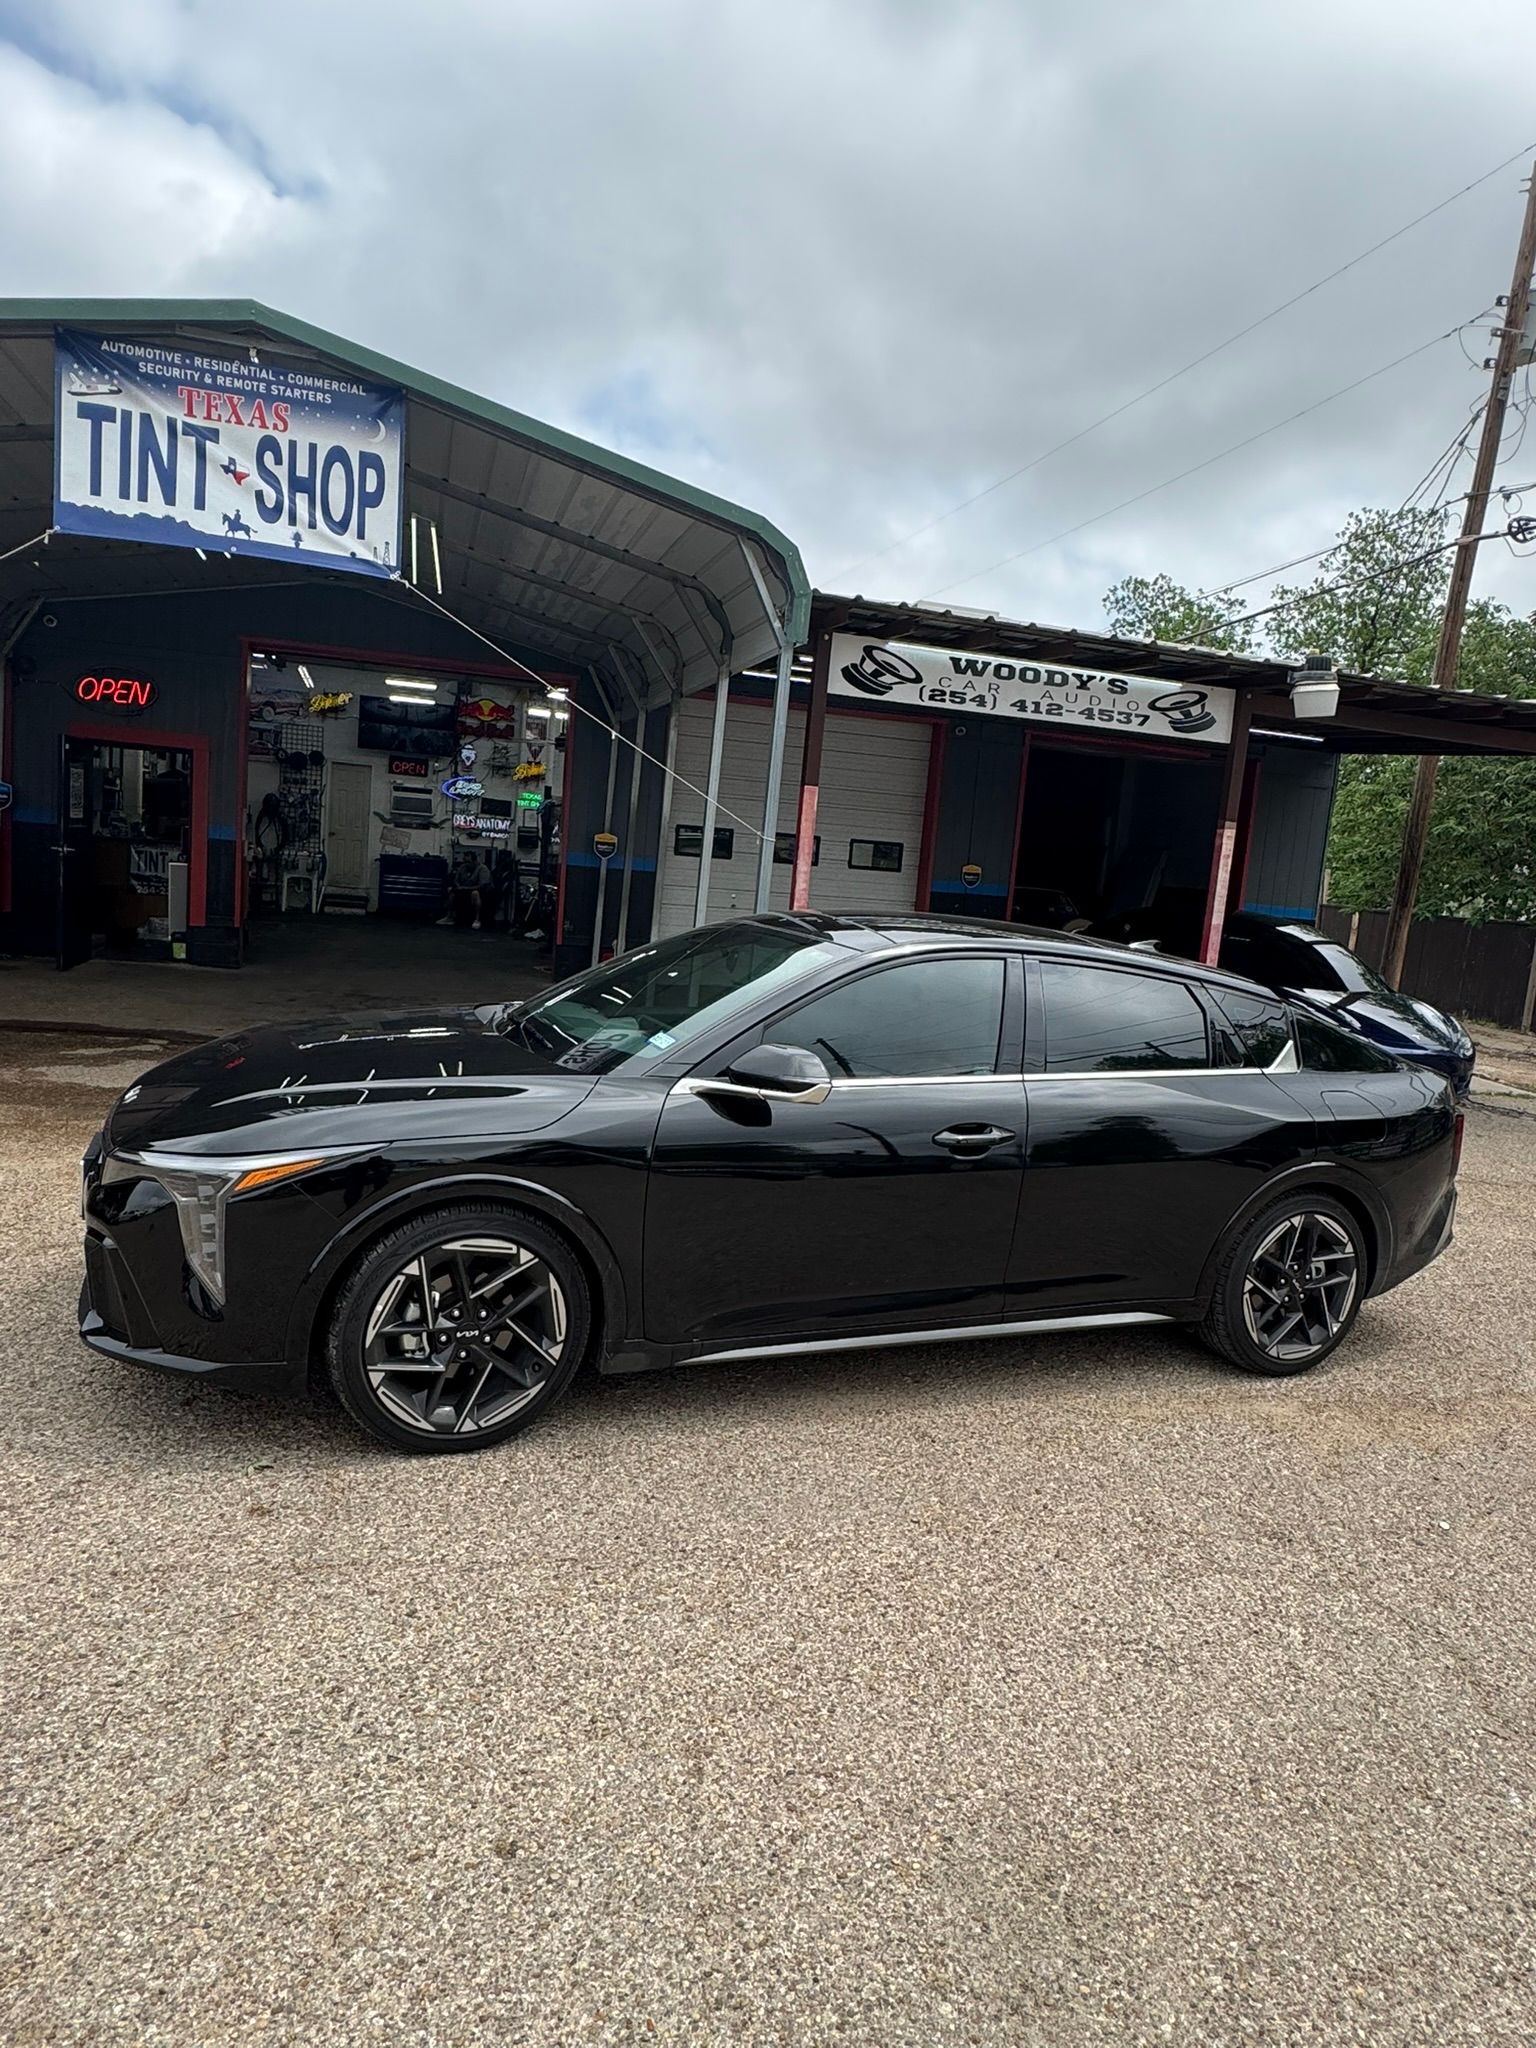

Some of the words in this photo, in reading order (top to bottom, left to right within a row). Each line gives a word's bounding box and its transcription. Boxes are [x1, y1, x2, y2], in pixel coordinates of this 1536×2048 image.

[101, 339, 182, 365] AUTOMOTIVE
[194, 356, 277, 382] RESIDENTIAL
[288, 373, 367, 397] COMMERCIAL
[138, 361, 201, 382] SECURITY
[204, 373, 212, 384] &
[217, 374, 267, 394] REMOTE
[271, 384, 333, 404] STARTERS
[178, 385, 291, 433] TEXAS
[76, 400, 220, 512] TINT
[255, 433, 386, 541] SHOP
[78, 677, 151, 705] OPEN
[938, 676, 1001, 695] CAR
[1040, 689, 1140, 711] AUDIO
[948, 656, 1129, 696] WOODY'S
[918, 686, 998, 711] (254)
[1010, 698, 1151, 726] 412-4537
[392, 761, 426, 775] OPEN
[134, 849, 169, 873] TINT
